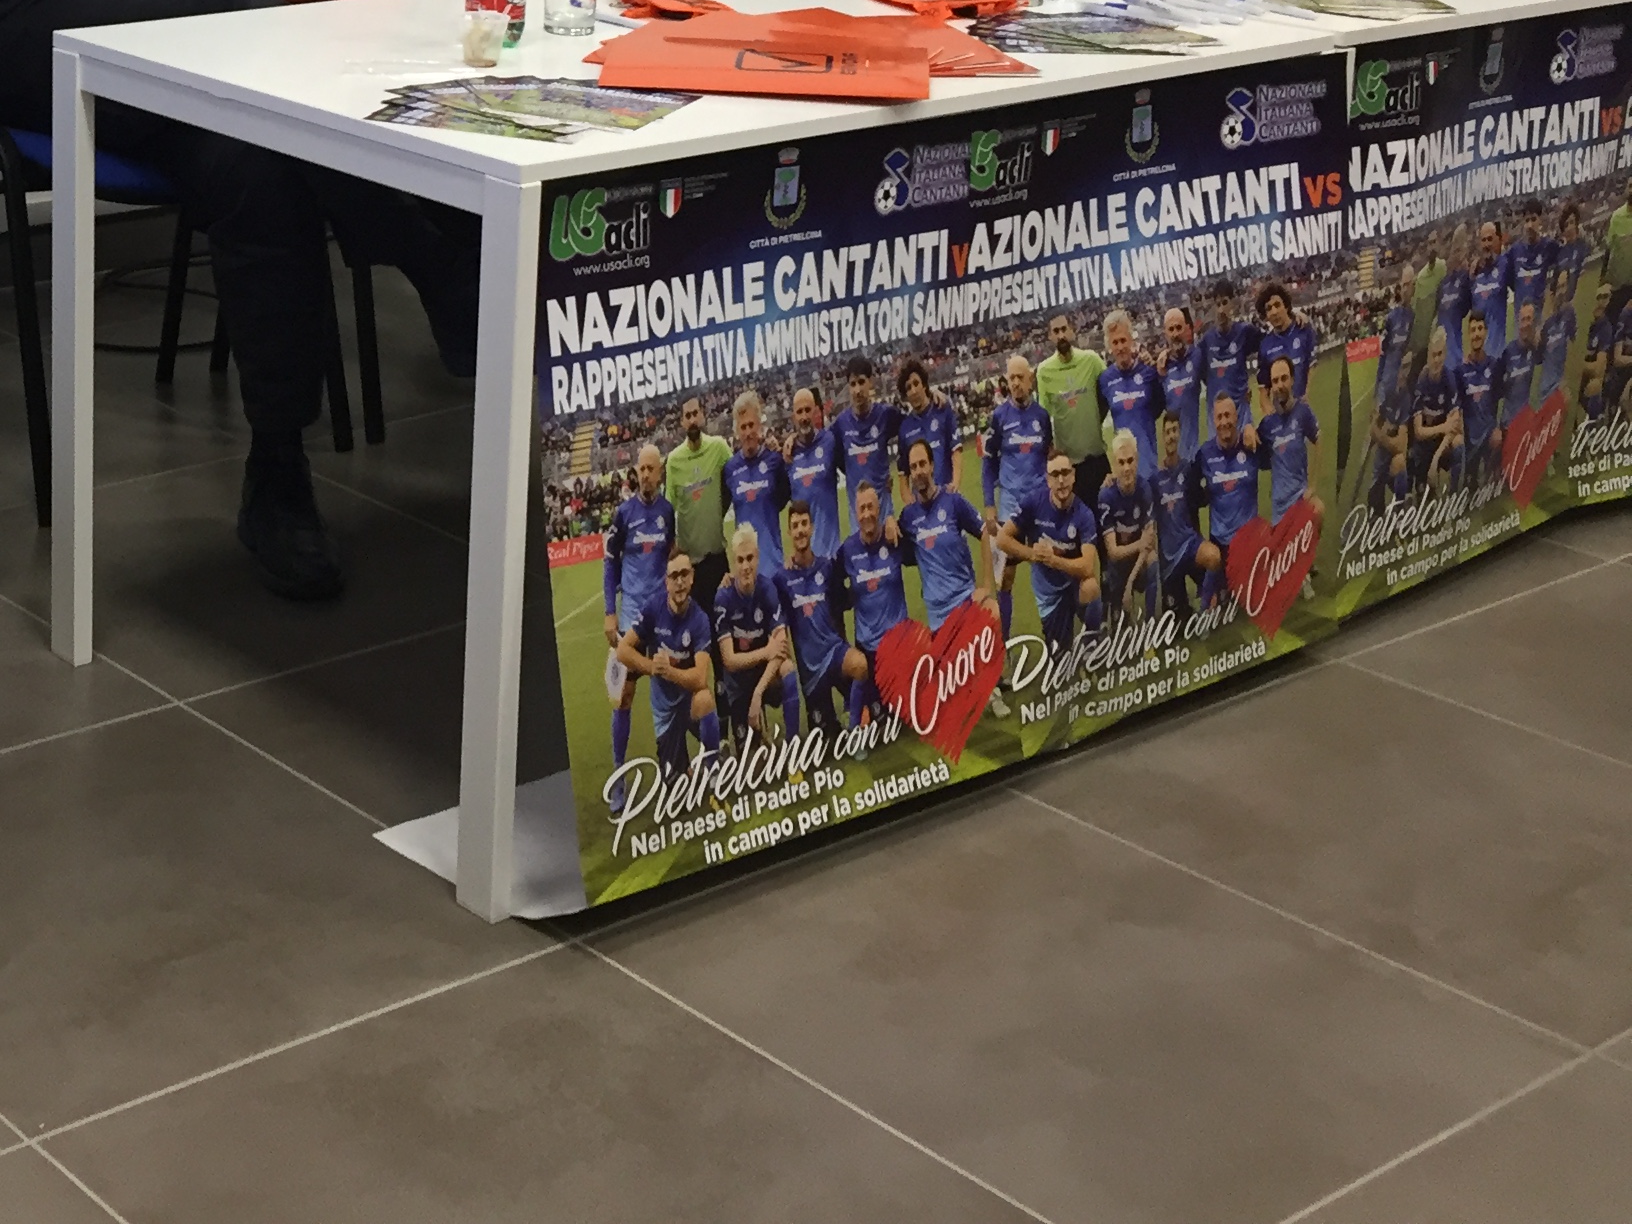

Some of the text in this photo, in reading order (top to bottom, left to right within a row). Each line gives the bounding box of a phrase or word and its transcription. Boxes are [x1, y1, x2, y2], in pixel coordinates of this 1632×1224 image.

[1478, 96, 1601, 160] CANTANTI
[1464, 149, 1572, 207] AMMINISTRATORI
[1574, 139, 1618, 185] SANNITI
[968, 192, 1130, 275] AZIONALE
[1135, 163, 1302, 238] CANTANTI
[1120, 222, 1267, 292] AMMINISTRATORI
[1270, 210, 1342, 262] SANNITI
[546, 261, 766, 357] NAZIONALE
[773, 229, 949, 311] CANTANTI
[572, 253, 651, 277] www.usacli.org
[551, 328, 750, 415] RAPPRESENTATIVA
[753, 294, 909, 371] AMMINISTRATORI
[1337, 481, 1469, 578] Pietrelcina
[1510, 408, 1562, 492] Cuore
[1577, 480, 1590, 497] in
[1598, 453, 1611, 472] di
[1184, 607, 1220, 641] con
[1245, 520, 1313, 617] Cuore
[1346, 558, 1366, 580] Nel
[1369, 544, 1403, 569] Paese
[1407, 536, 1420, 555] di
[1422, 524, 1454, 551] Padre
[1386, 568, 1397, 586] in
[1400, 553, 1439, 580] campo
[1440, 544, 1457, 567] per
[1470, 512, 1521, 549] solidarietà
[1020, 646, 1190, 725] Nel Paese di Padre Pio
[1068, 636, 1266, 725] in campo per la solidarietà
[603, 625, 997, 857] Pietrelcina con il Cuore
[630, 768, 845, 859] Nel Paese di Padre Pio
[703, 758, 951, 864] in campo per la solidarietà
